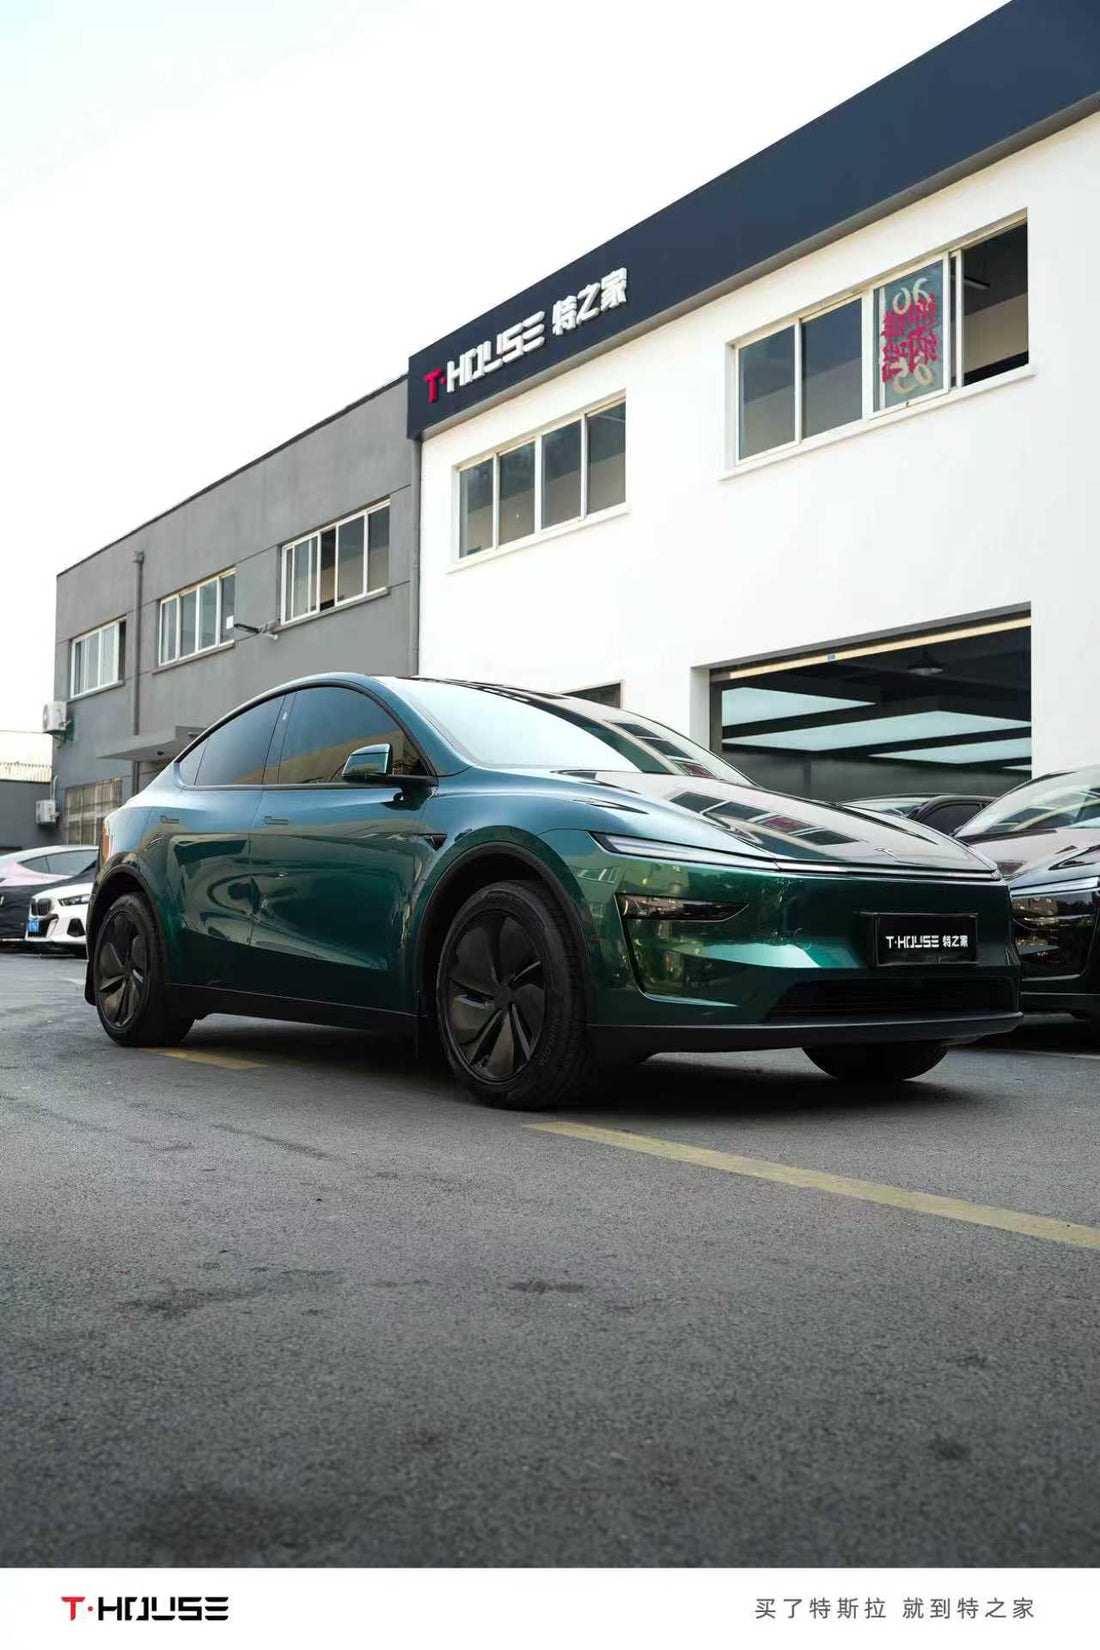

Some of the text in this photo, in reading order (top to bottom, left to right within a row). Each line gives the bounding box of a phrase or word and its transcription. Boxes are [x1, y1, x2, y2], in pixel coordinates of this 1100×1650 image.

[551, 267, 628, 335] 特之家
[942, 935, 969, 948] 特之家
